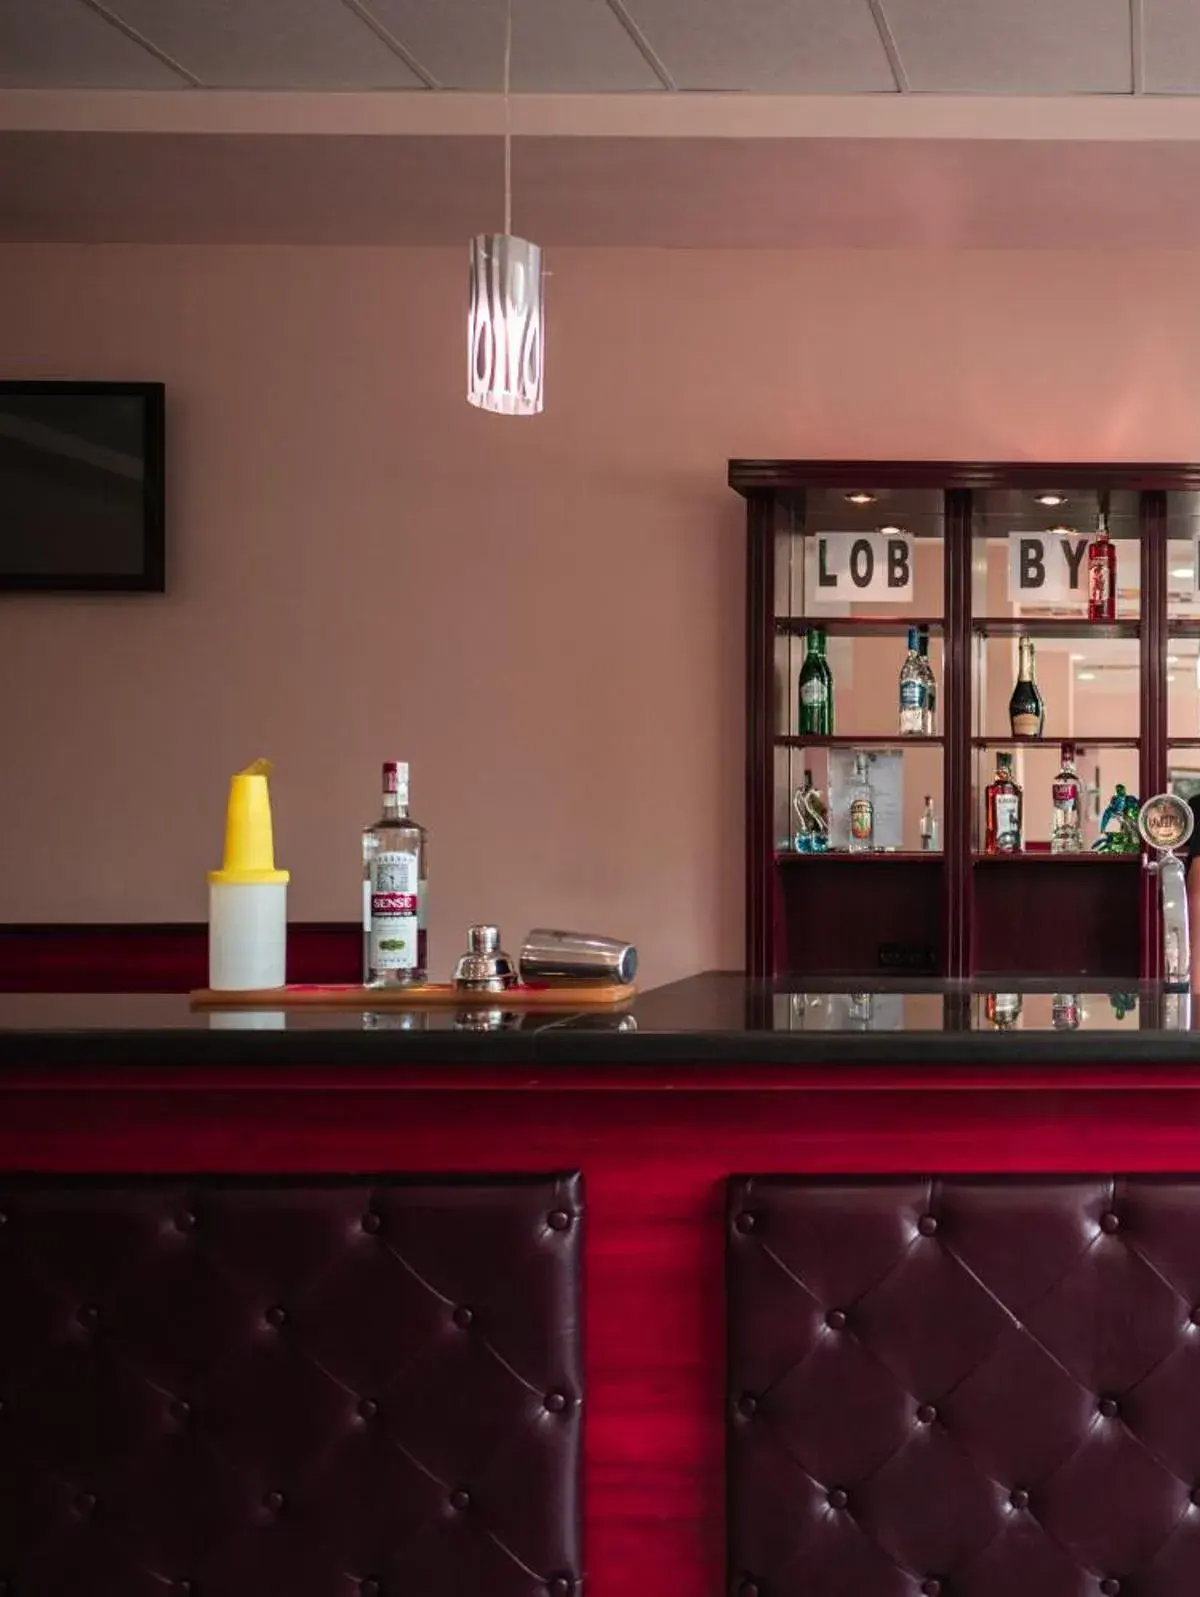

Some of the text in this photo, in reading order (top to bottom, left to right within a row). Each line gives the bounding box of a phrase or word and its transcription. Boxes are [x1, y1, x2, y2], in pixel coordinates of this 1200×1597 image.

[819, 539, 909, 588] LOB
[1020, 539, 1088, 589] BY
[373, 896, 412, 908] SENSE
